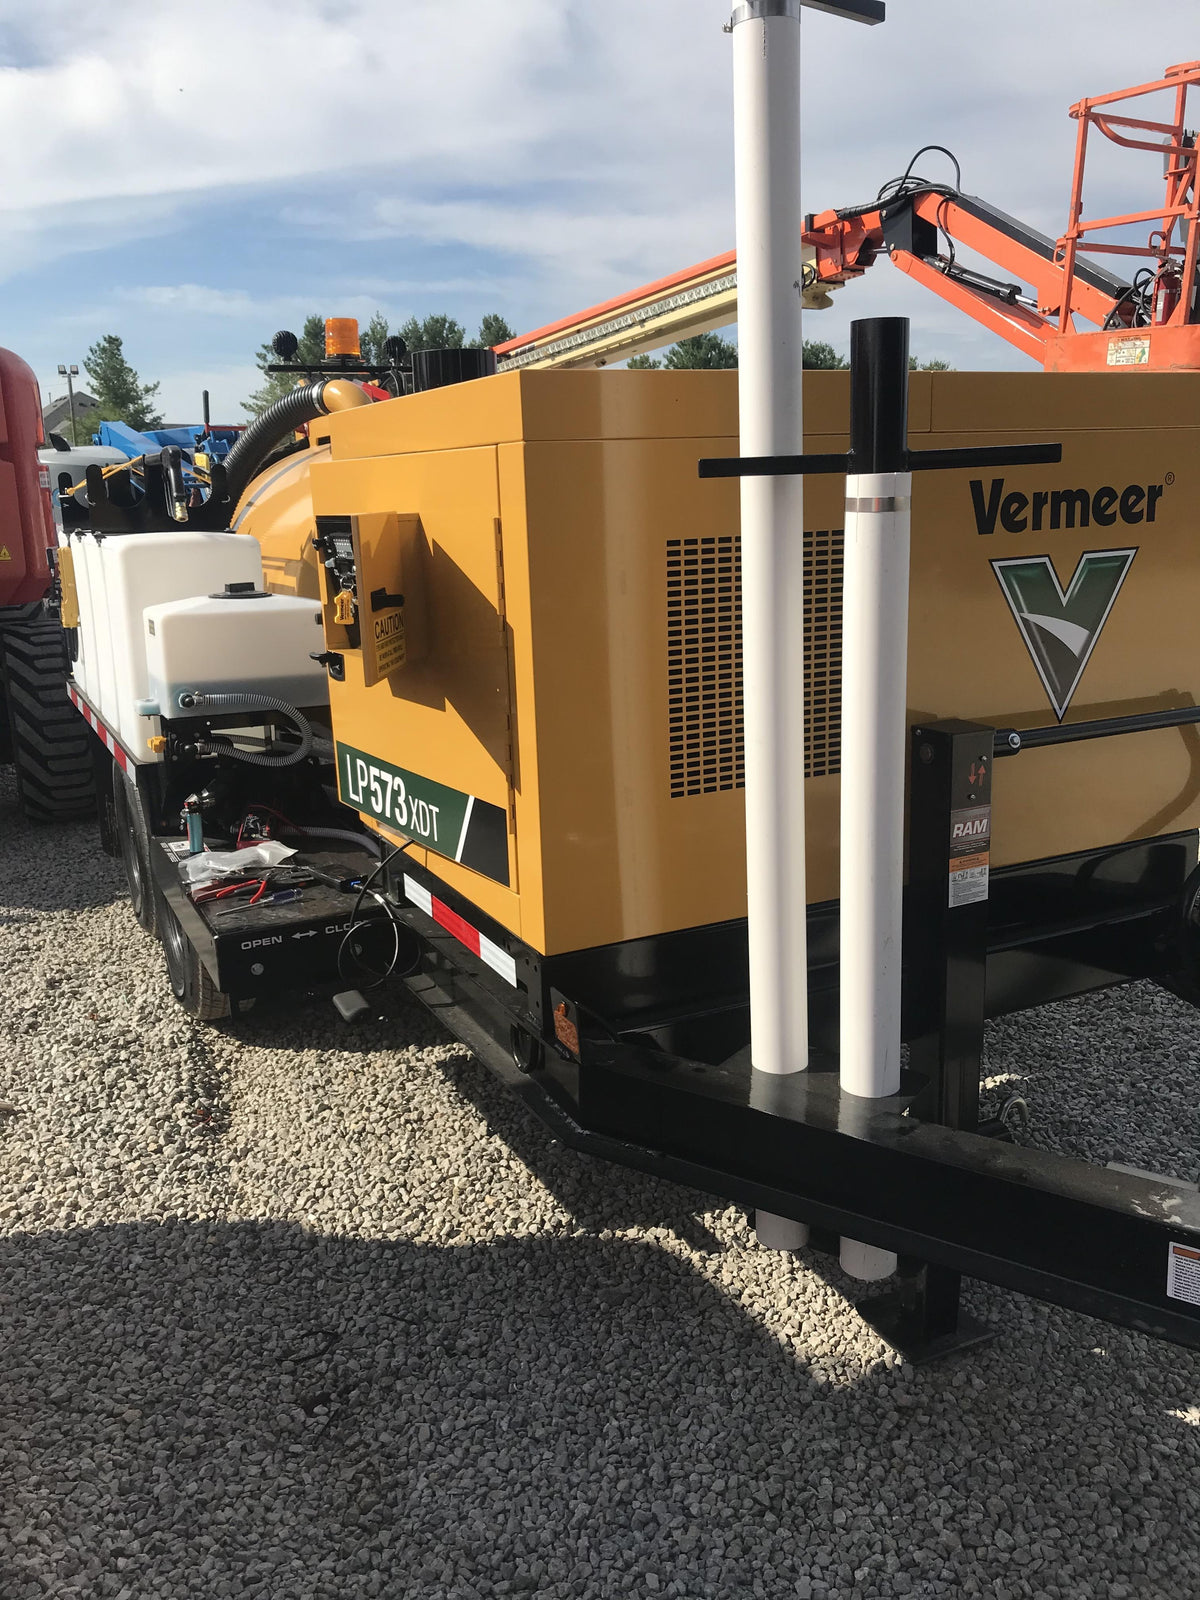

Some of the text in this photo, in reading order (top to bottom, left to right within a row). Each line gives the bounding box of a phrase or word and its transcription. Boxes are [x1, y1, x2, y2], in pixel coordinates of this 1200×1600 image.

[374, 612, 404, 640] CAUTION
[952, 818, 988, 838] RAM
[241, 935, 282, 950] OPEN
